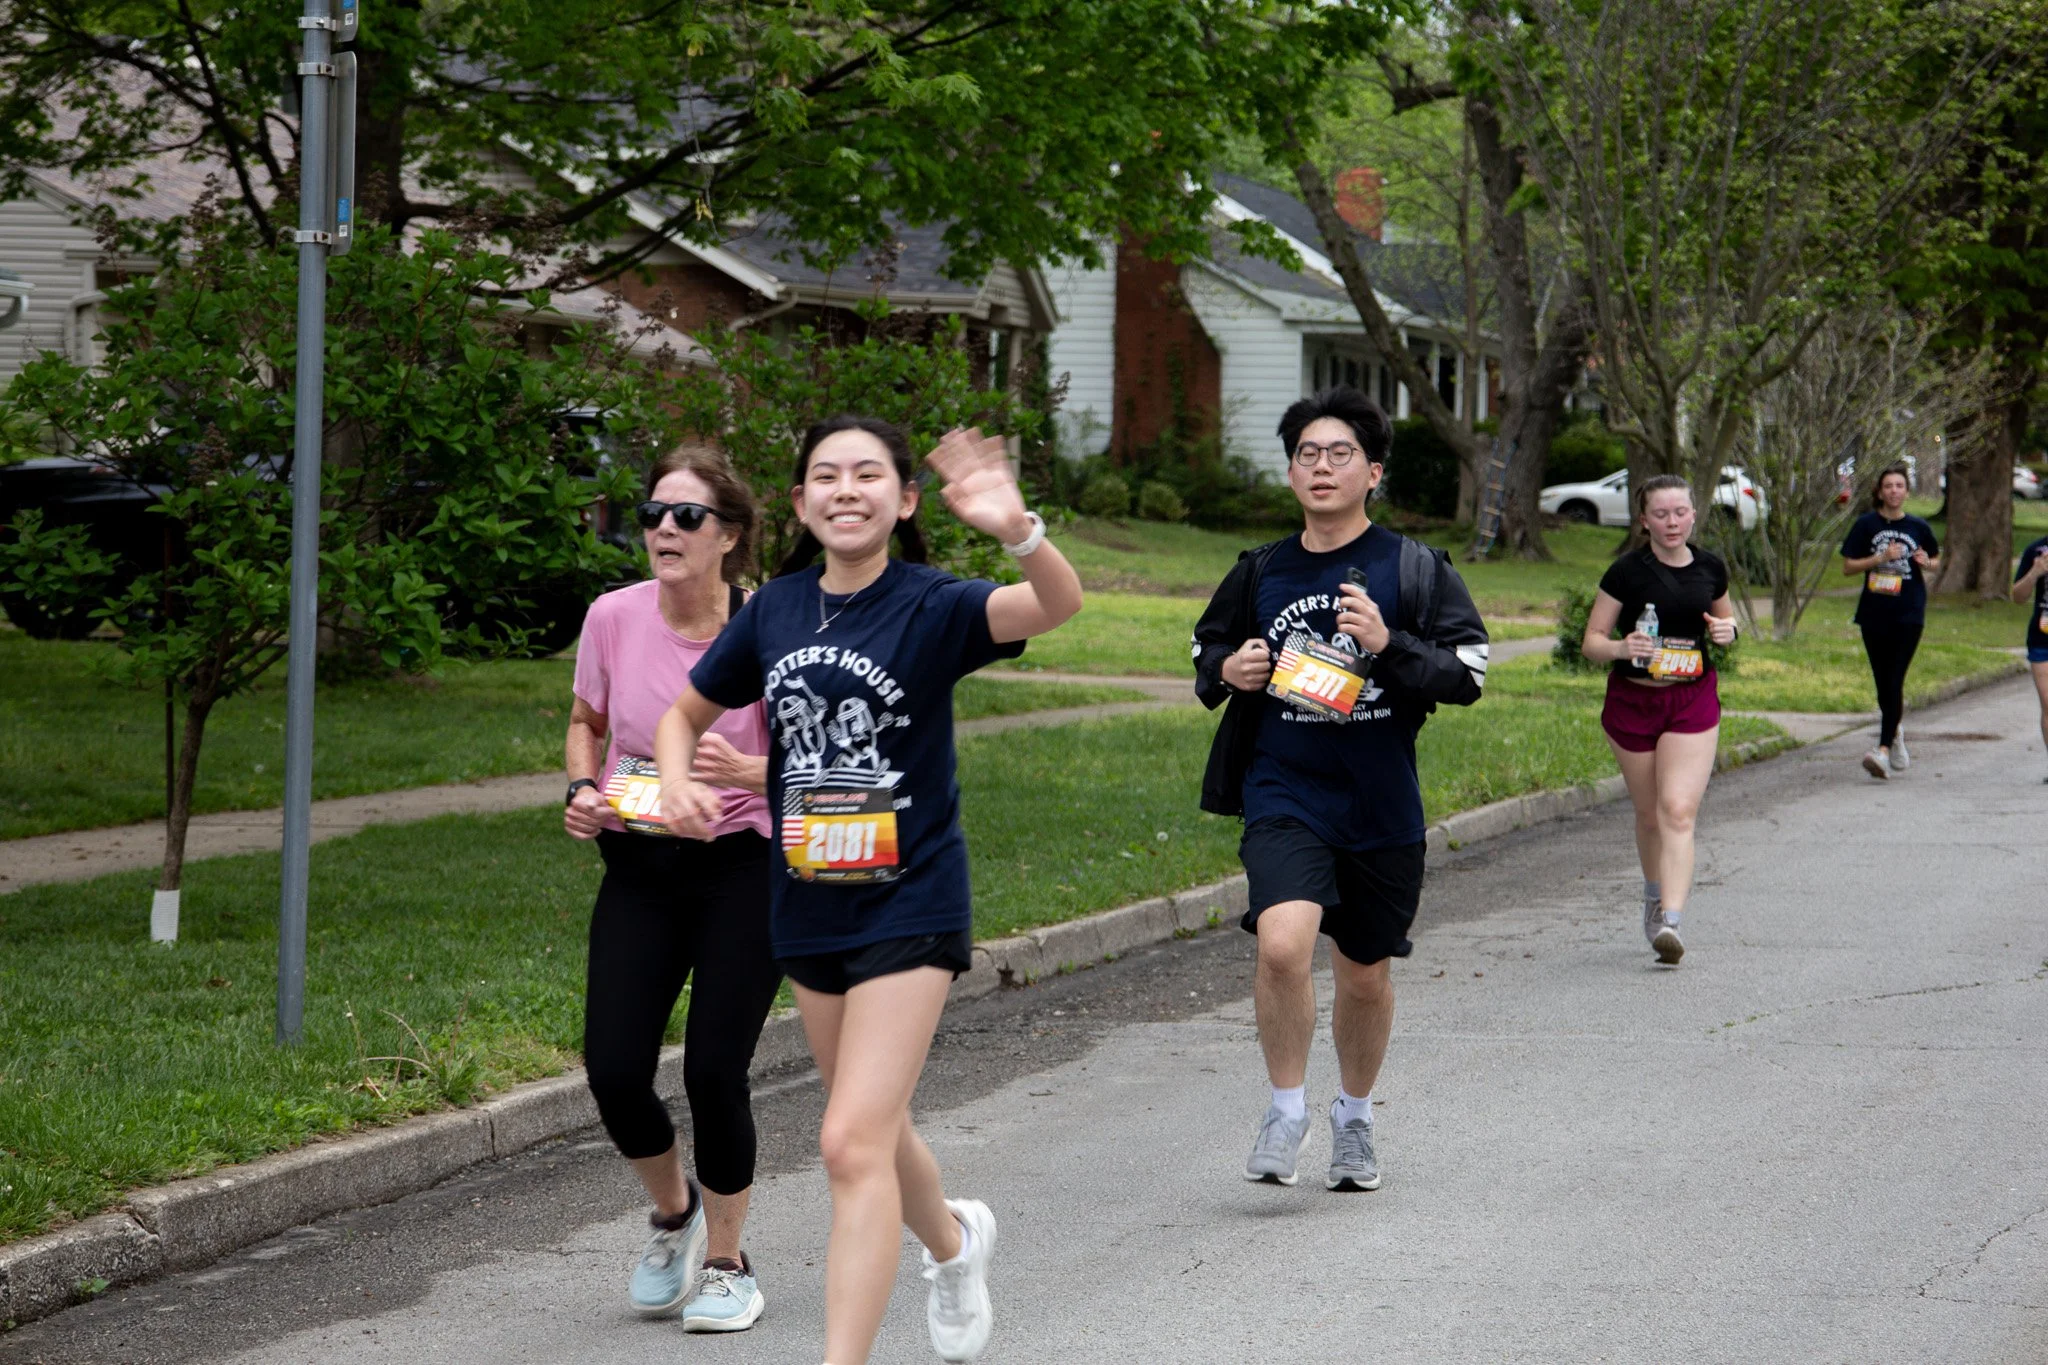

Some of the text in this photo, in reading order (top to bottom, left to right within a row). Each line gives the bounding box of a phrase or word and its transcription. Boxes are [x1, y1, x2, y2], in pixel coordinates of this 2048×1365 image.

[1268, 594, 1330, 641] POTTER'S
[764, 645, 906, 707] POTTER'S HOUSE
[1352, 711, 1372, 721] FUN
[1373, 707, 1391, 719] RUN
[618, 782, 661, 816] 20
[806, 821, 879, 863] 2081
